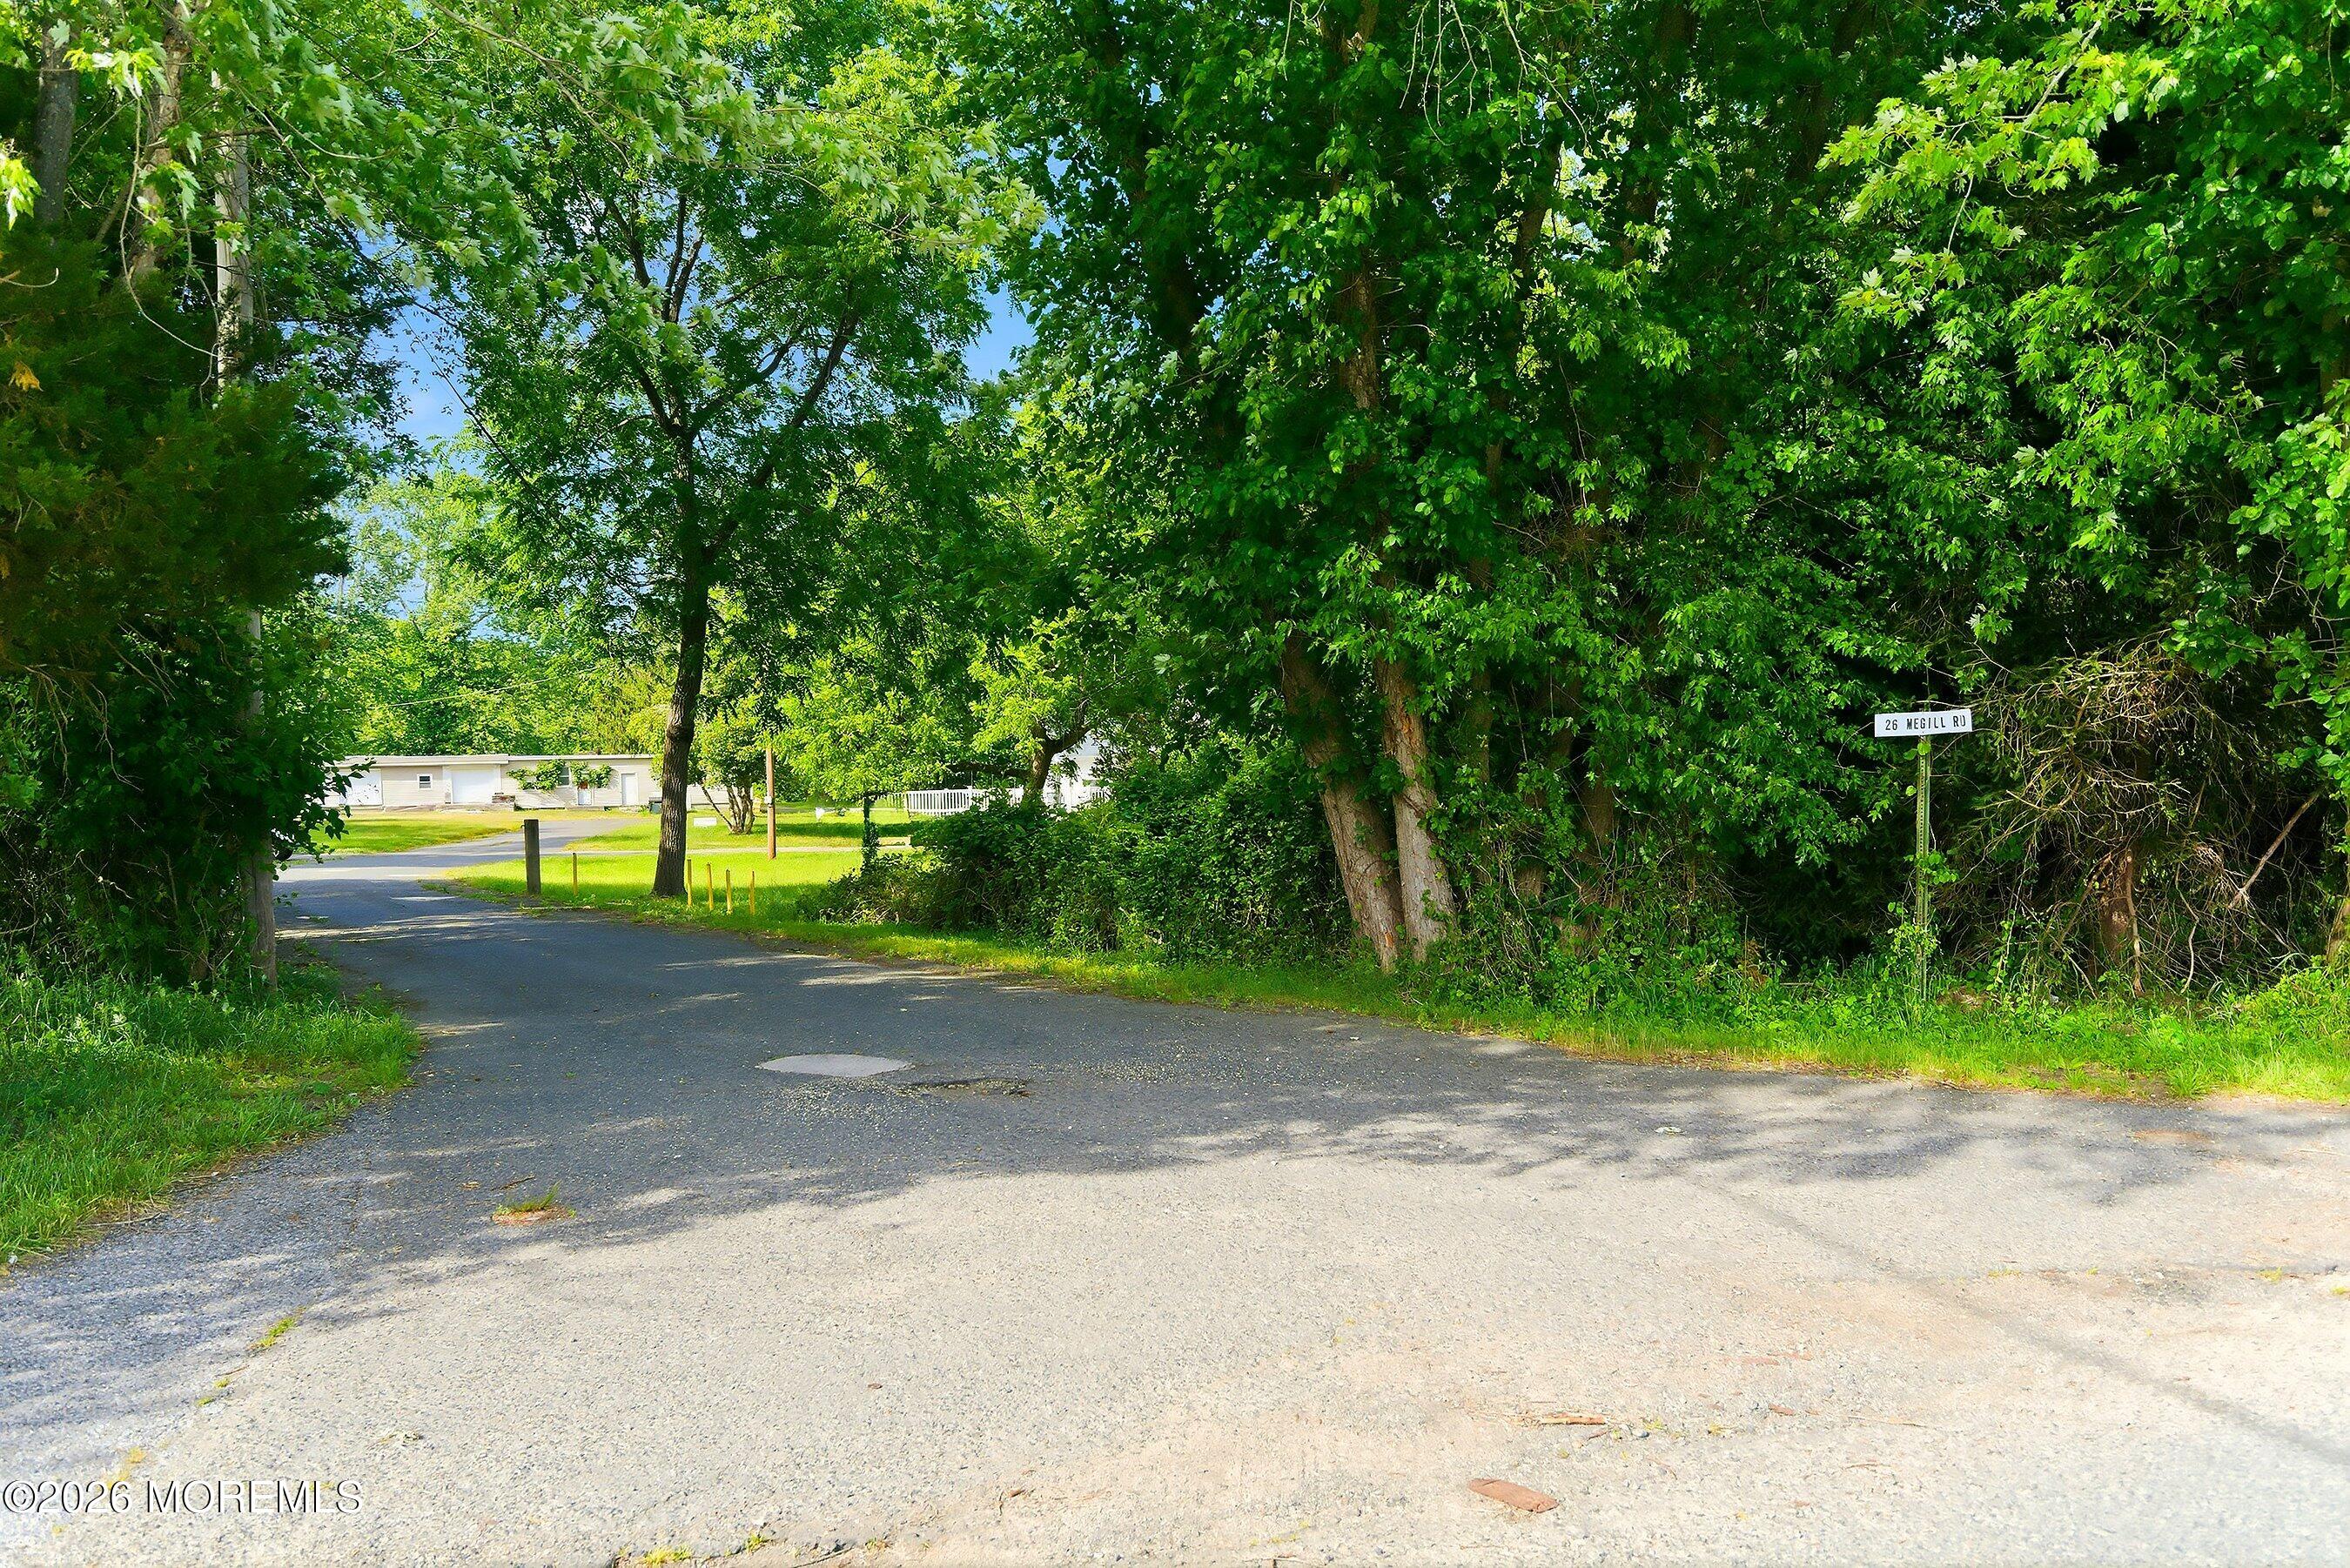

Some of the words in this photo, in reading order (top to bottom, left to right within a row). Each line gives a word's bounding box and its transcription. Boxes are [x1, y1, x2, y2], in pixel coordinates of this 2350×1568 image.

[1885, 720, 1897, 730] 26
[1906, 717, 1946, 729] MEGILL
[1952, 715, 1966, 727] RD
